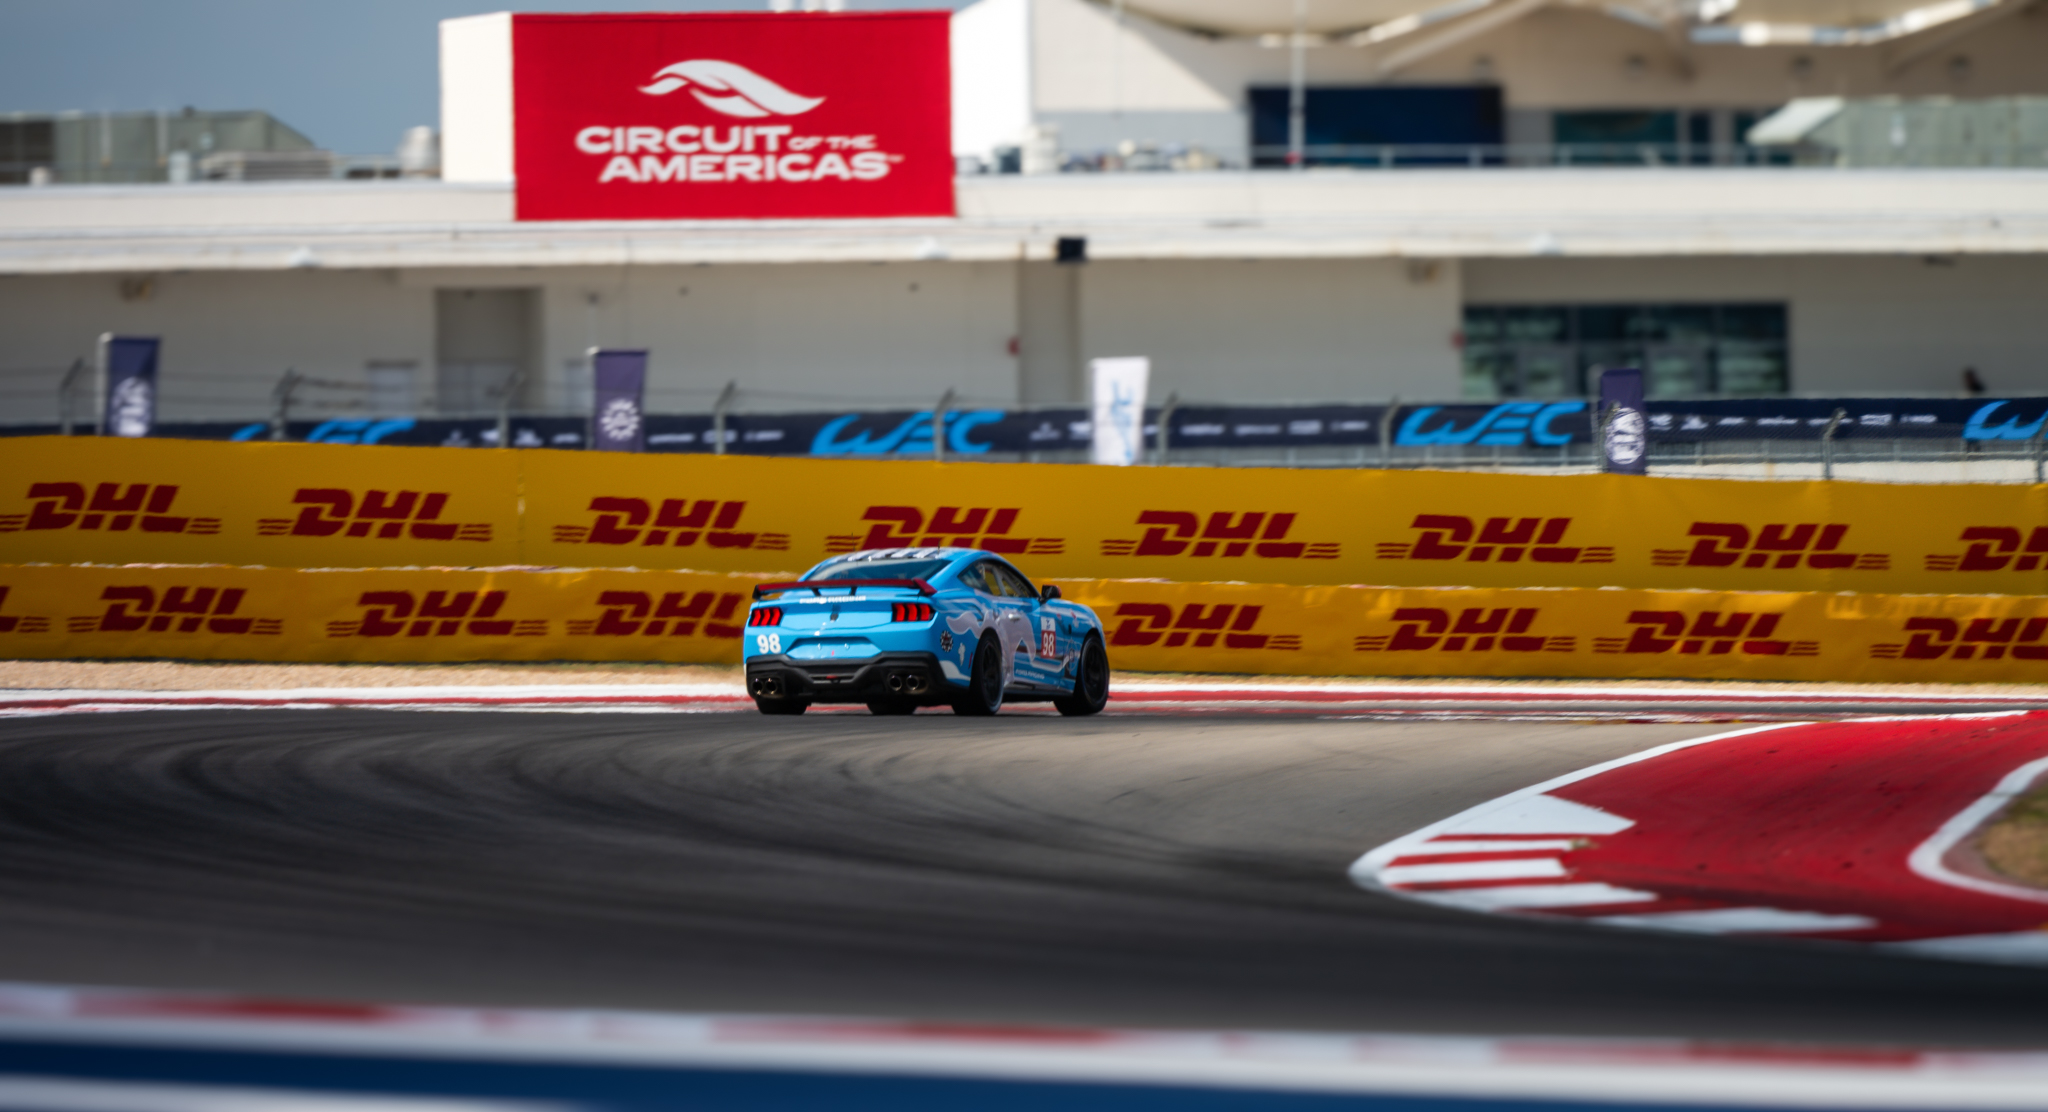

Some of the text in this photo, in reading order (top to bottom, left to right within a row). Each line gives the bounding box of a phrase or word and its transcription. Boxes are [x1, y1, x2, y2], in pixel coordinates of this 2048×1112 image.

[575, 124, 878, 154] CIRCUIT OF THE
[598, 152, 891, 183] AMERICAS
[810, 409, 1006, 455] WEC
[1395, 401, 1587, 446] WEC
[24, 482, 190, 533] DHL
[290, 488, 460, 541] DHL
[586, 496, 758, 550] DHL
[861, 505, 1031, 554] DHL
[1134, 510, 1307, 559] DHL
[1408, 514, 1583, 563] DHL
[1685, 521, 1858, 570] DHL
[100, 586, 253, 635] DHL
[357, 590, 515, 638] DHL
[594, 590, 744, 639] DHL
[1110, 602, 1271, 650] DHL
[1385, 607, 1547, 653] DHL
[1624, 610, 1792, 656] DHL
[757, 633, 781, 655] 98
[1043, 632, 1055, 657] 98
[1900, 617, 2048, 660] DHL
